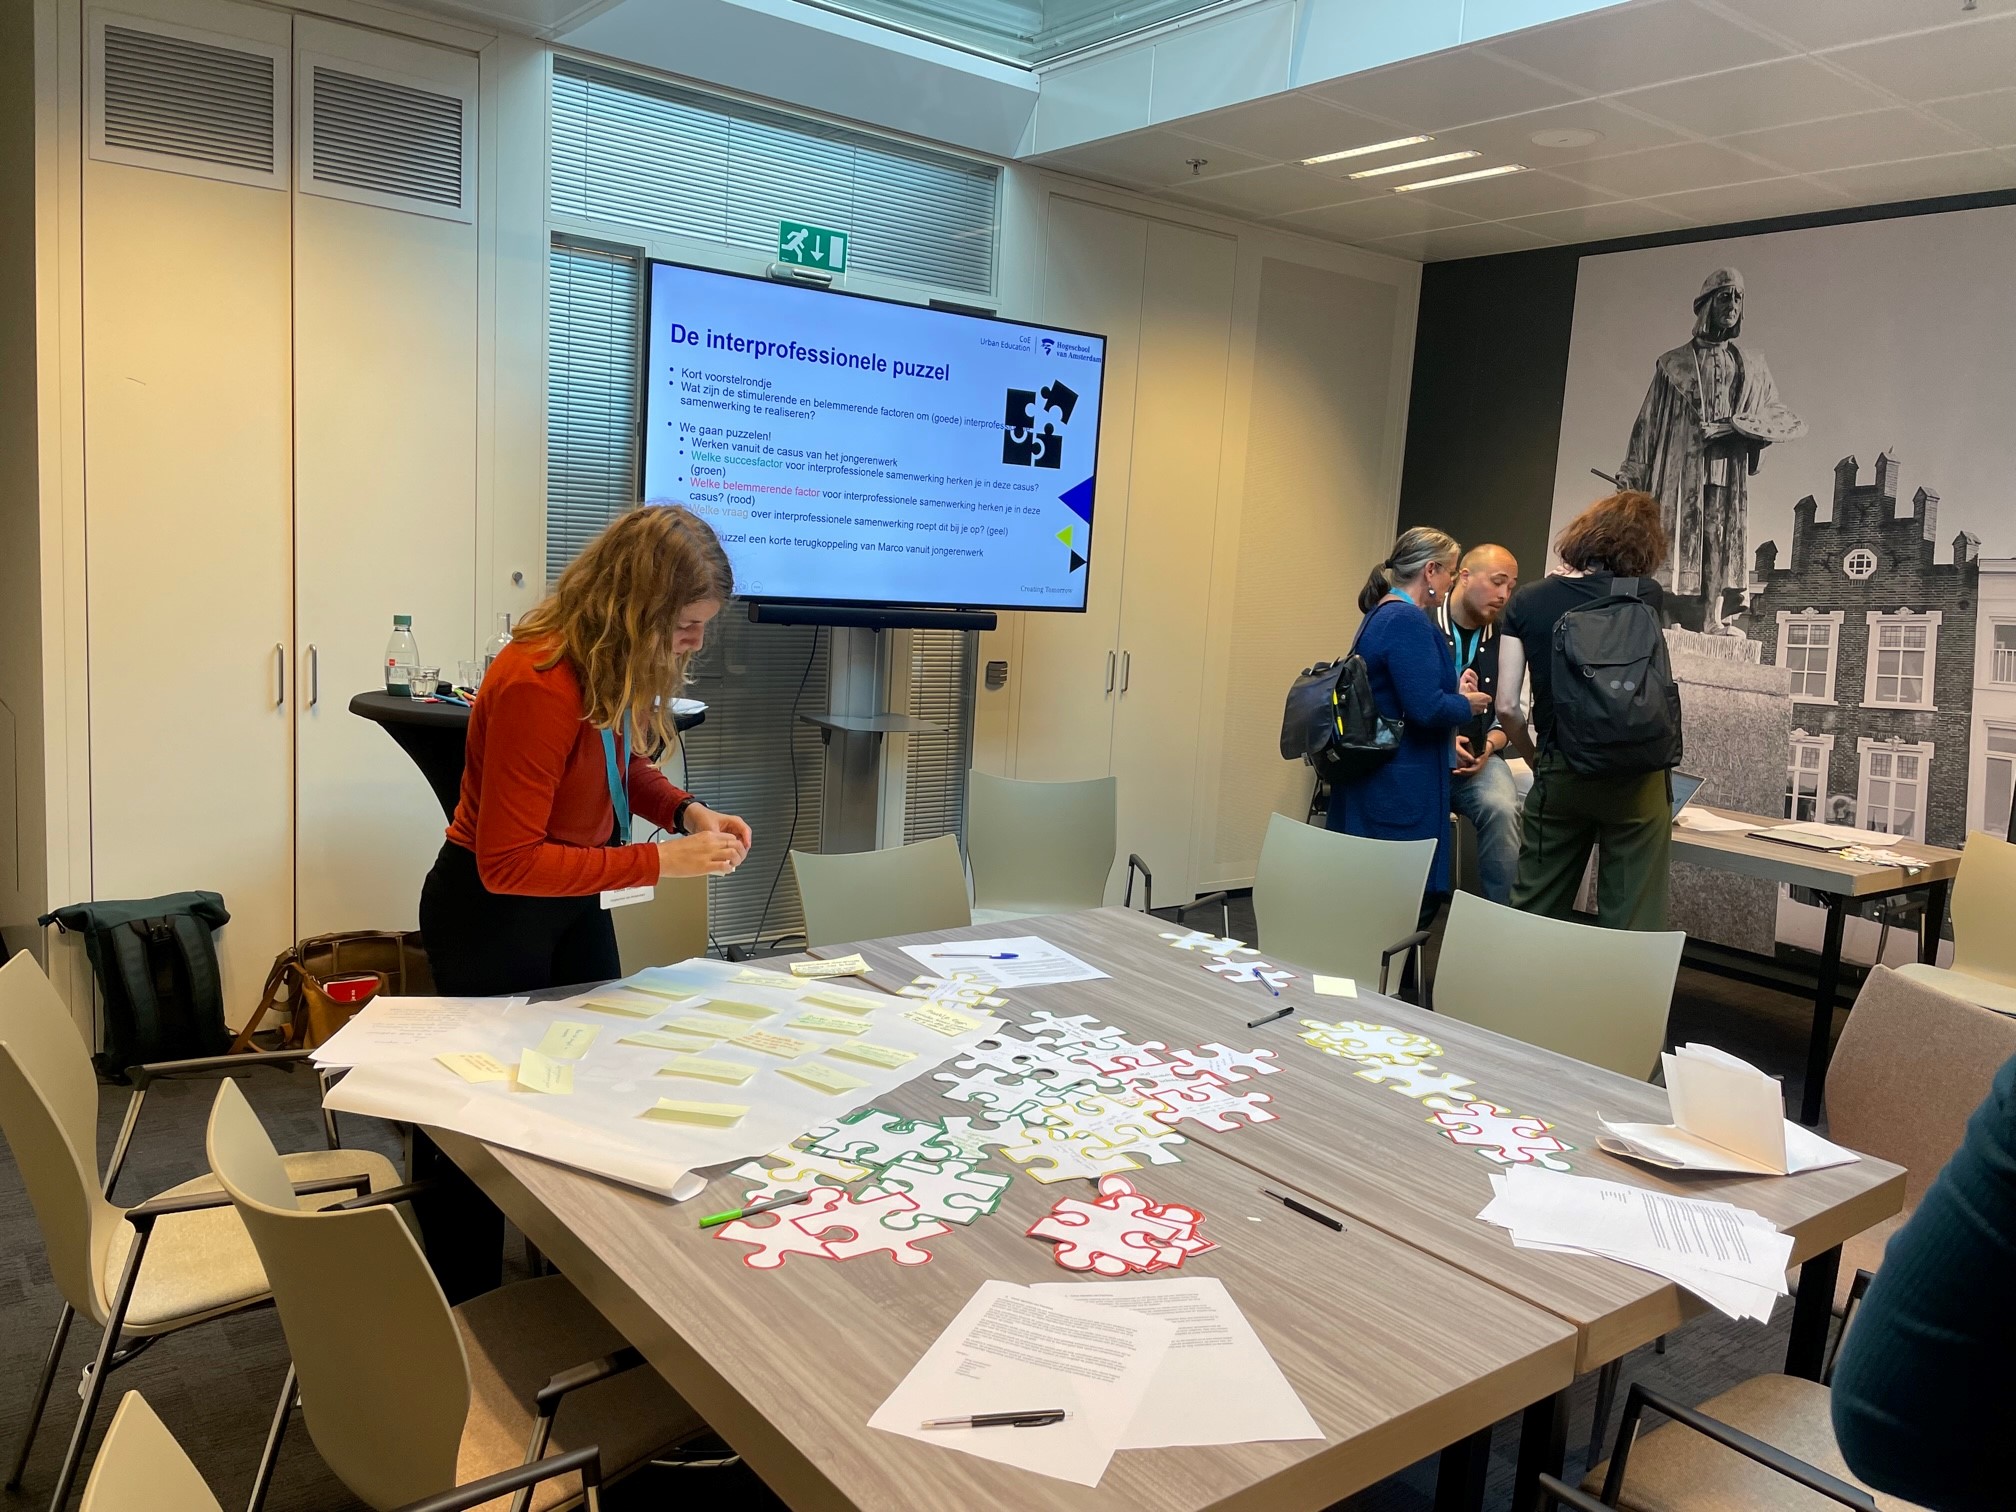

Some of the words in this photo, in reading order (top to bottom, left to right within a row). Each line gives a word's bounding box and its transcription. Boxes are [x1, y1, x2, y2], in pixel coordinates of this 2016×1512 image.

[980, 338, 999, 348] Urban
[1001, 341, 1031, 352] Education
[1019, 335, 1031, 344] CoE
[1057, 341, 1090, 353] Hogeschool
[671, 323, 699, 345] De
[707, 328, 887, 372] interprofessionele
[893, 359, 950, 381] puzzel
[1068, 352, 1101, 363] Amsterdam
[681, 368, 702, 380] Kort
[705, 374, 772, 389] voorstelrondje
[680, 396, 751, 414] samenwerking
[753, 404, 763, 414] te
[765, 405, 816, 420] realiseren?
[681, 381, 701, 394] Wat
[703, 384, 720, 397] zijn
[722, 387, 735, 398] de
[737, 389, 797, 406] stimulerende
[799, 397, 811, 407] en
[814, 398, 879, 416] belemmerende
[881, 407, 914, 419] factoren
[916, 412, 930, 421] om
[931, 412, 962, 426] (goede)
[680, 422, 696, 434] We
[699, 426, 723, 437] gaan
[726, 428, 772, 441] puzzelen!
[692, 437, 729, 451] Werken
[732, 442, 760, 454] vanuit
[762, 443, 775, 455] de
[777, 447, 804, 458] casus
[806, 450, 822, 461] van
[824, 449, 839, 462] het
[840, 452, 898, 467] jongerenwerk
[690, 465, 726, 478] (groen)
[691, 451, 722, 463] Welke
[724, 455, 784, 469] succesfactor
[786, 460, 805, 471] voor
[807, 461, 884, 479] interprofessionele
[886, 470, 944, 486] samenwerking
[946, 475, 973, 487] herken
[974, 477, 983, 489] je
[984, 478, 991, 488] in
[993, 479, 1011, 490] deze
[1013, 481, 1039, 492] casus?
[689, 491, 724, 502] casus?
[727, 495, 756, 506] (rood)
[690, 477, 720, 489] Welke
[723, 480, 792, 495] belemmerende
[795, 486, 820, 497] factor
[822, 490, 842, 500] voor
[843, 490, 918, 506] interprofessionele
[919, 498, 976, 512] samenwerking
[978, 503, 1004, 513] herken
[1005, 504, 1013, 514] je
[1014, 504, 1021, 514] in
[1023, 505, 1041, 515] deze
[689, 503, 720, 515] Welke
[722, 508, 749, 520] vraag
[751, 510, 771, 519] over
[774, 509, 852, 525] interprofessionele
[854, 518, 914, 531] samenwerking
[916, 521, 937, 533] roept
[939, 522, 949, 531] dit
[950, 523, 960, 534] bij
[961, 524, 968, 534] je
[970, 525, 984, 536] op?
[986, 526, 1009, 537] (geel)
[749, 535, 766, 544] een
[769, 535, 792, 546] korte
[794, 537, 858, 551] terugkoppeling
[860, 542, 875, 552] van
[878, 542, 904, 553] Marco
[905, 544, 930, 554] vanuit
[931, 545, 984, 558] jongerenwerk
